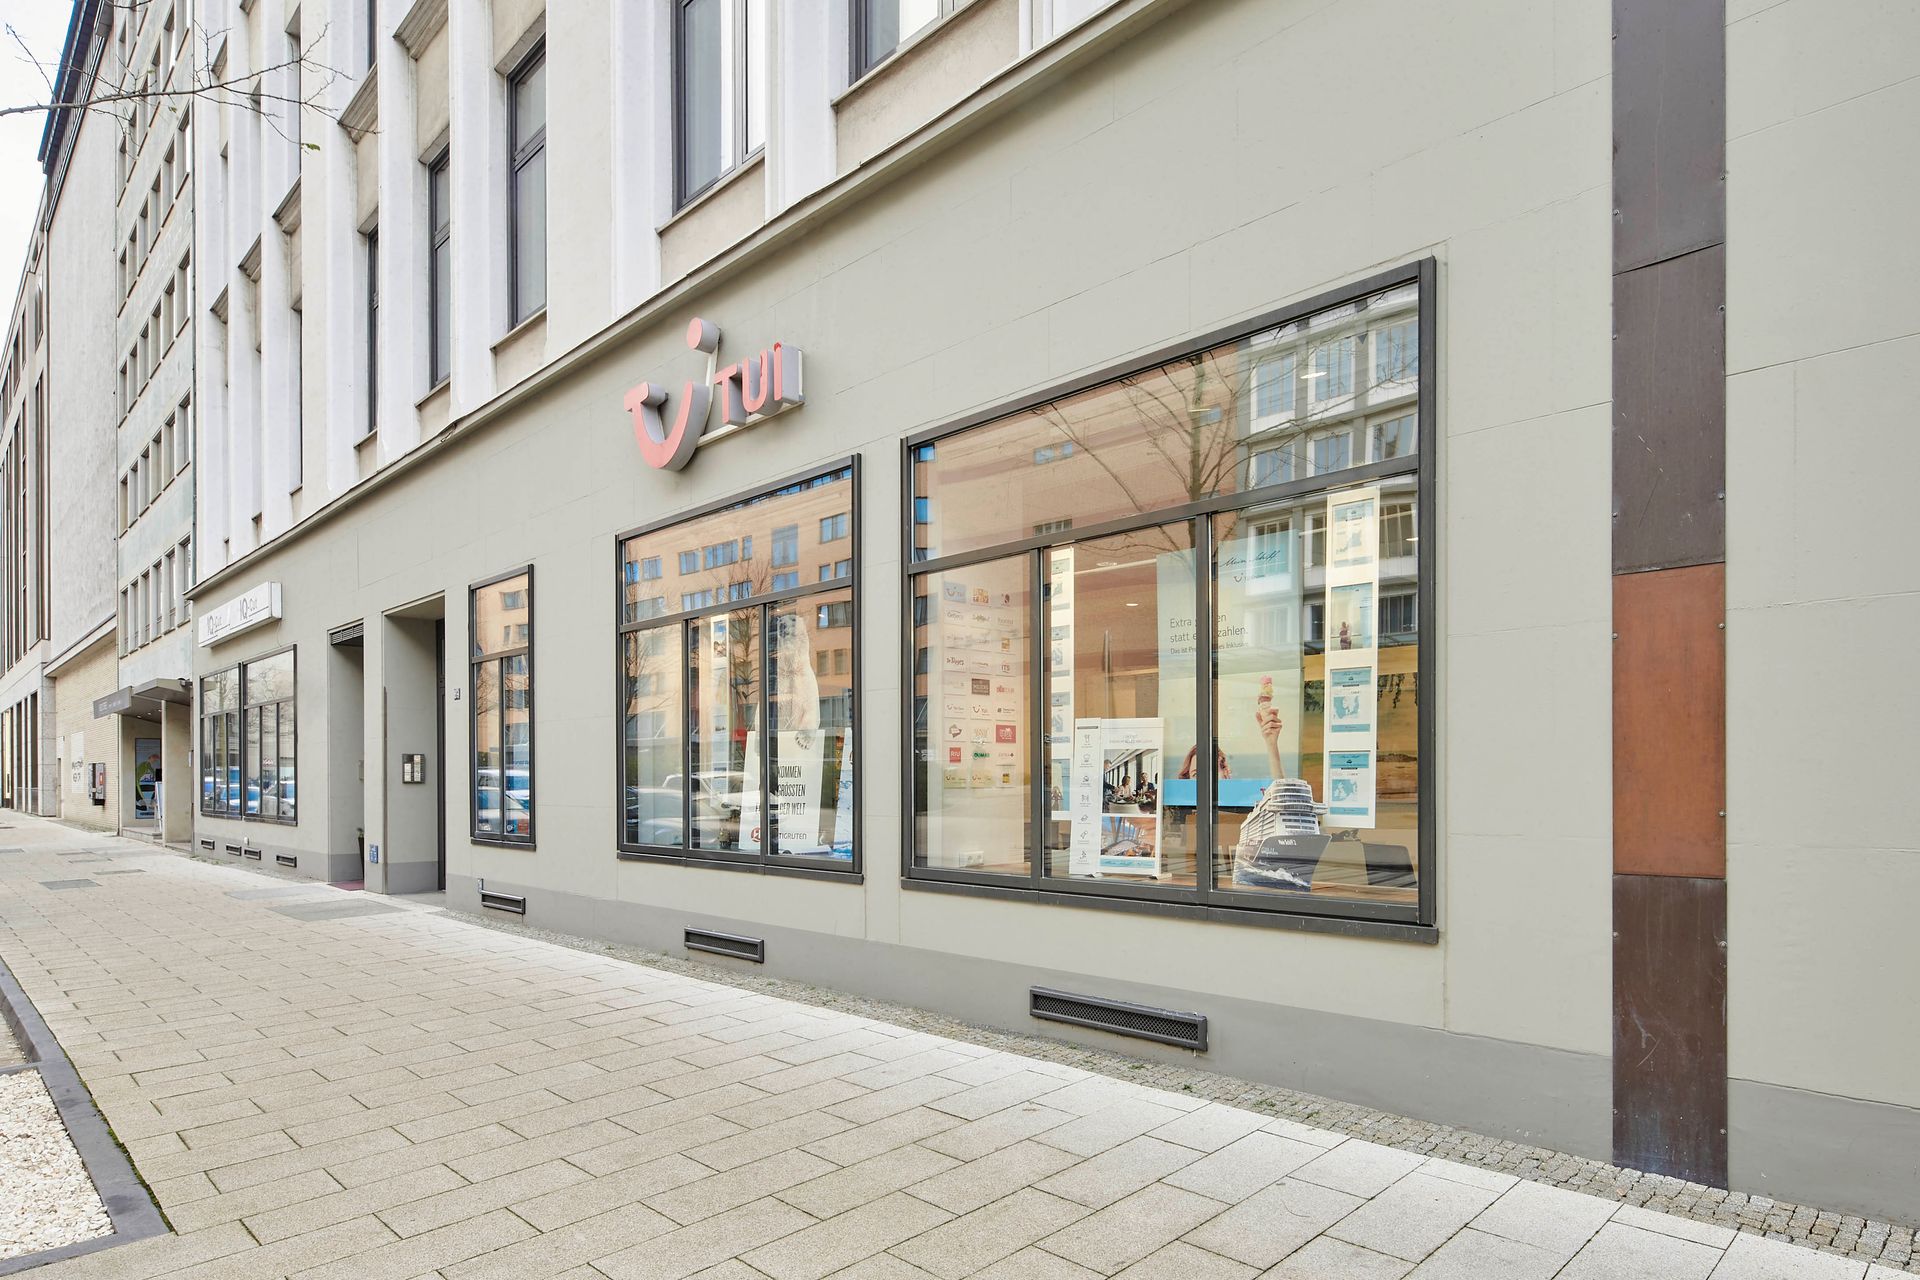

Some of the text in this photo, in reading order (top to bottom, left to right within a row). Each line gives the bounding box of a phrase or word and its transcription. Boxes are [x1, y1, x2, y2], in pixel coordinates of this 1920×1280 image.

[714, 341, 796, 427] TUI
[1170, 618, 1192, 629] Extra
[1170, 632, 1190, 643] statt
[791, 803, 806, 815] WELT
